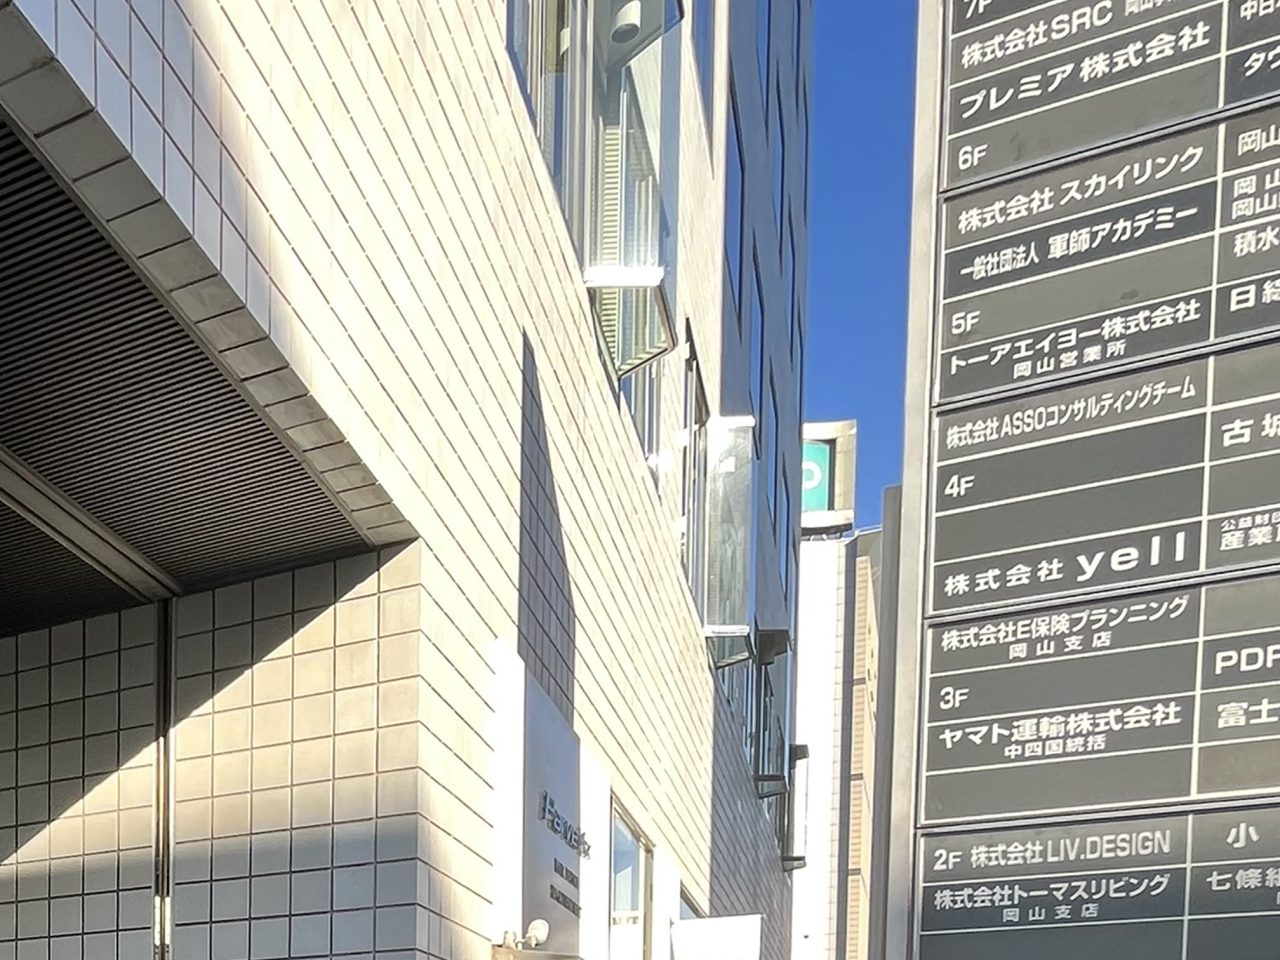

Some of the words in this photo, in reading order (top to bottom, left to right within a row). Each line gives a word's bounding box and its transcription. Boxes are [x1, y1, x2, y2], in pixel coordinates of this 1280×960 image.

[958, 144, 988, 170] 6F
[1231, 192, 1280, 220] 岡山
[951, 310, 981, 335] 5F
[950, 298, 1201, 375] トーアエイヨー株式会社
[1013, 341, 1126, 379] 岡山営業所
[944, 474, 975, 497] 4F
[1220, 525, 1280, 551] 産業
[942, 595, 1190, 652] 株式会社E保険プランニング
[1009, 631, 1112, 660] 岡山支店
[940, 686, 969, 710] 3F
[939, 701, 1182, 749] ヤマト運輸株式会社
[1004, 735, 1106, 758] 中四国統括
[1226, 822, 1260, 848] 小
[933, 849, 962, 871] 2F
[934, 874, 1170, 910] 株式会社トーマスリビング
[1003, 903, 1099, 922] 岡山支店
